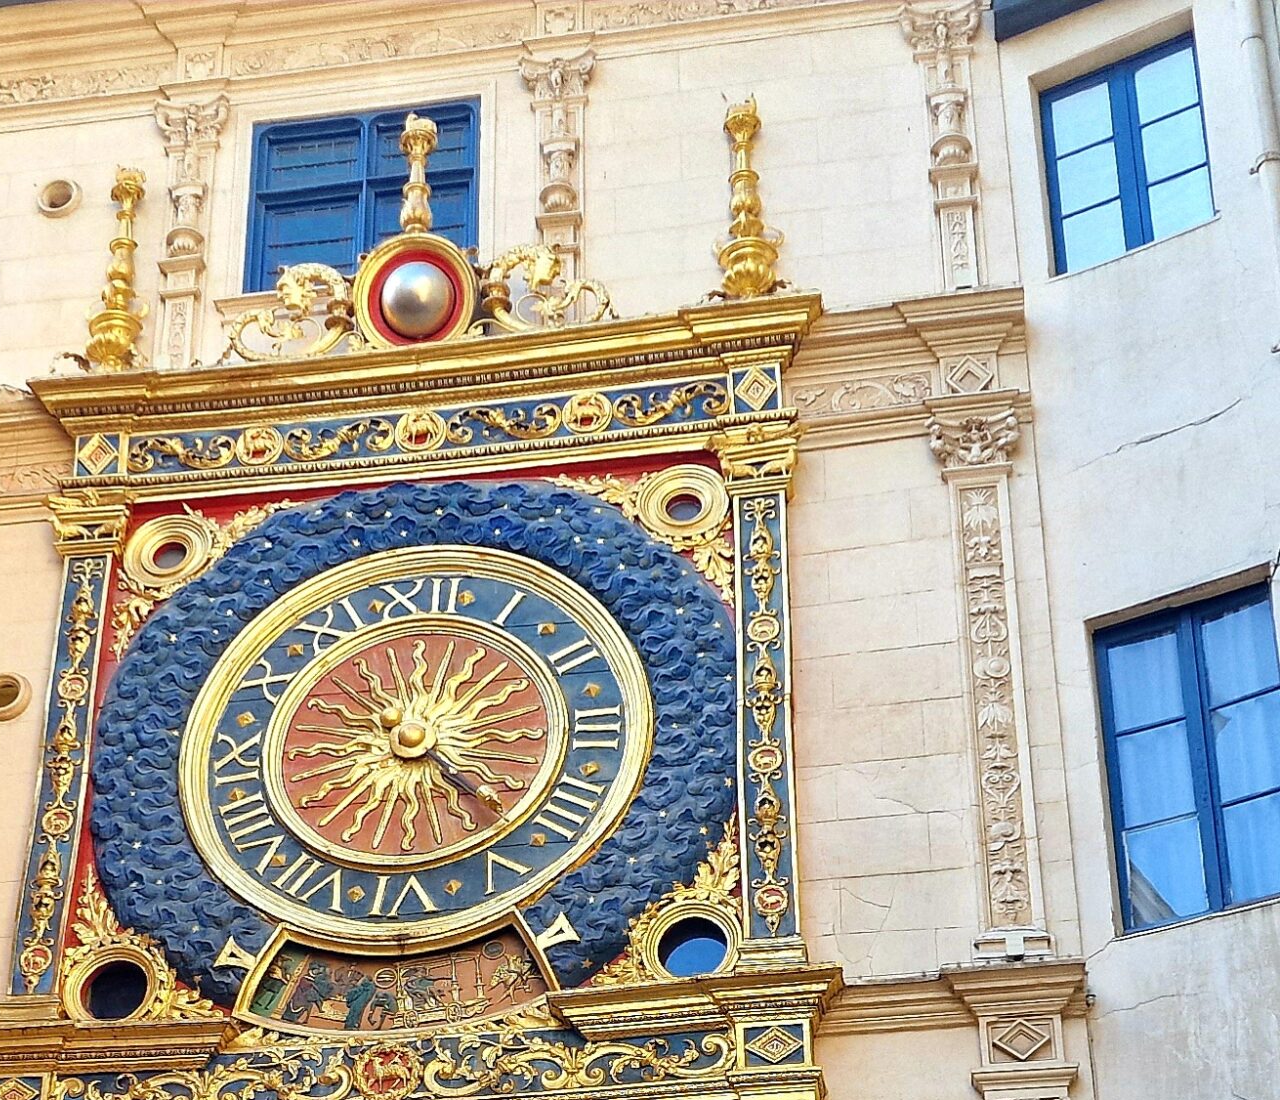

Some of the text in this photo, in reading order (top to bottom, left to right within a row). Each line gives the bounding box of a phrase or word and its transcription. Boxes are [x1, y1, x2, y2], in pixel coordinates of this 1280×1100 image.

[380, 577, 463, 621] XII
[492, 590, 527, 627] I
[546, 635, 601, 676] II
[573, 704, 621, 750] III
[214, 731, 263, 787] IX
[532, 773, 606, 841] IIII
[218, 791, 285, 877] VIII
[271, 852, 343, 914] VII
[485, 851, 533, 895] V
[368, 875, 440, 919] VI
